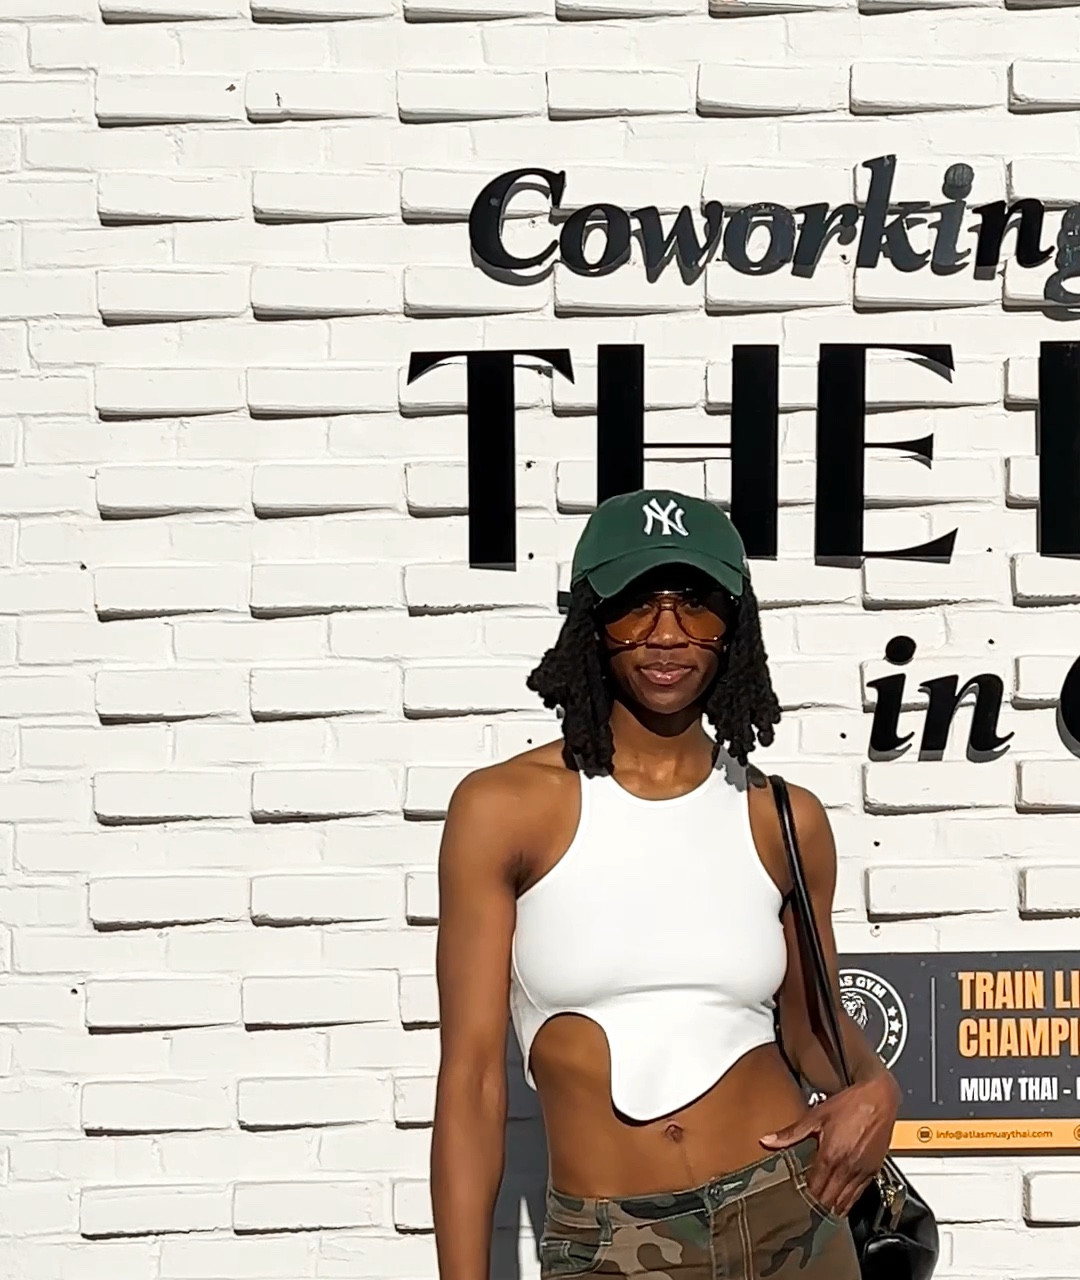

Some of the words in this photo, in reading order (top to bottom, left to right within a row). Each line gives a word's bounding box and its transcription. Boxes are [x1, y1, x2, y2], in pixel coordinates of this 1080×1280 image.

[406, 343, 958, 568] THE
[642, 498, 689, 536] NY
[866, 634, 1015, 761] in
[855, 976, 888, 999] GYM
[957, 970, 1046, 1010] TRAIN
[960, 1077, 1013, 1102] MUAY
[1018, 1077, 1059, 1101] THAI
[936, 1129, 1053, 1140] info@atlasmuaythai.com
